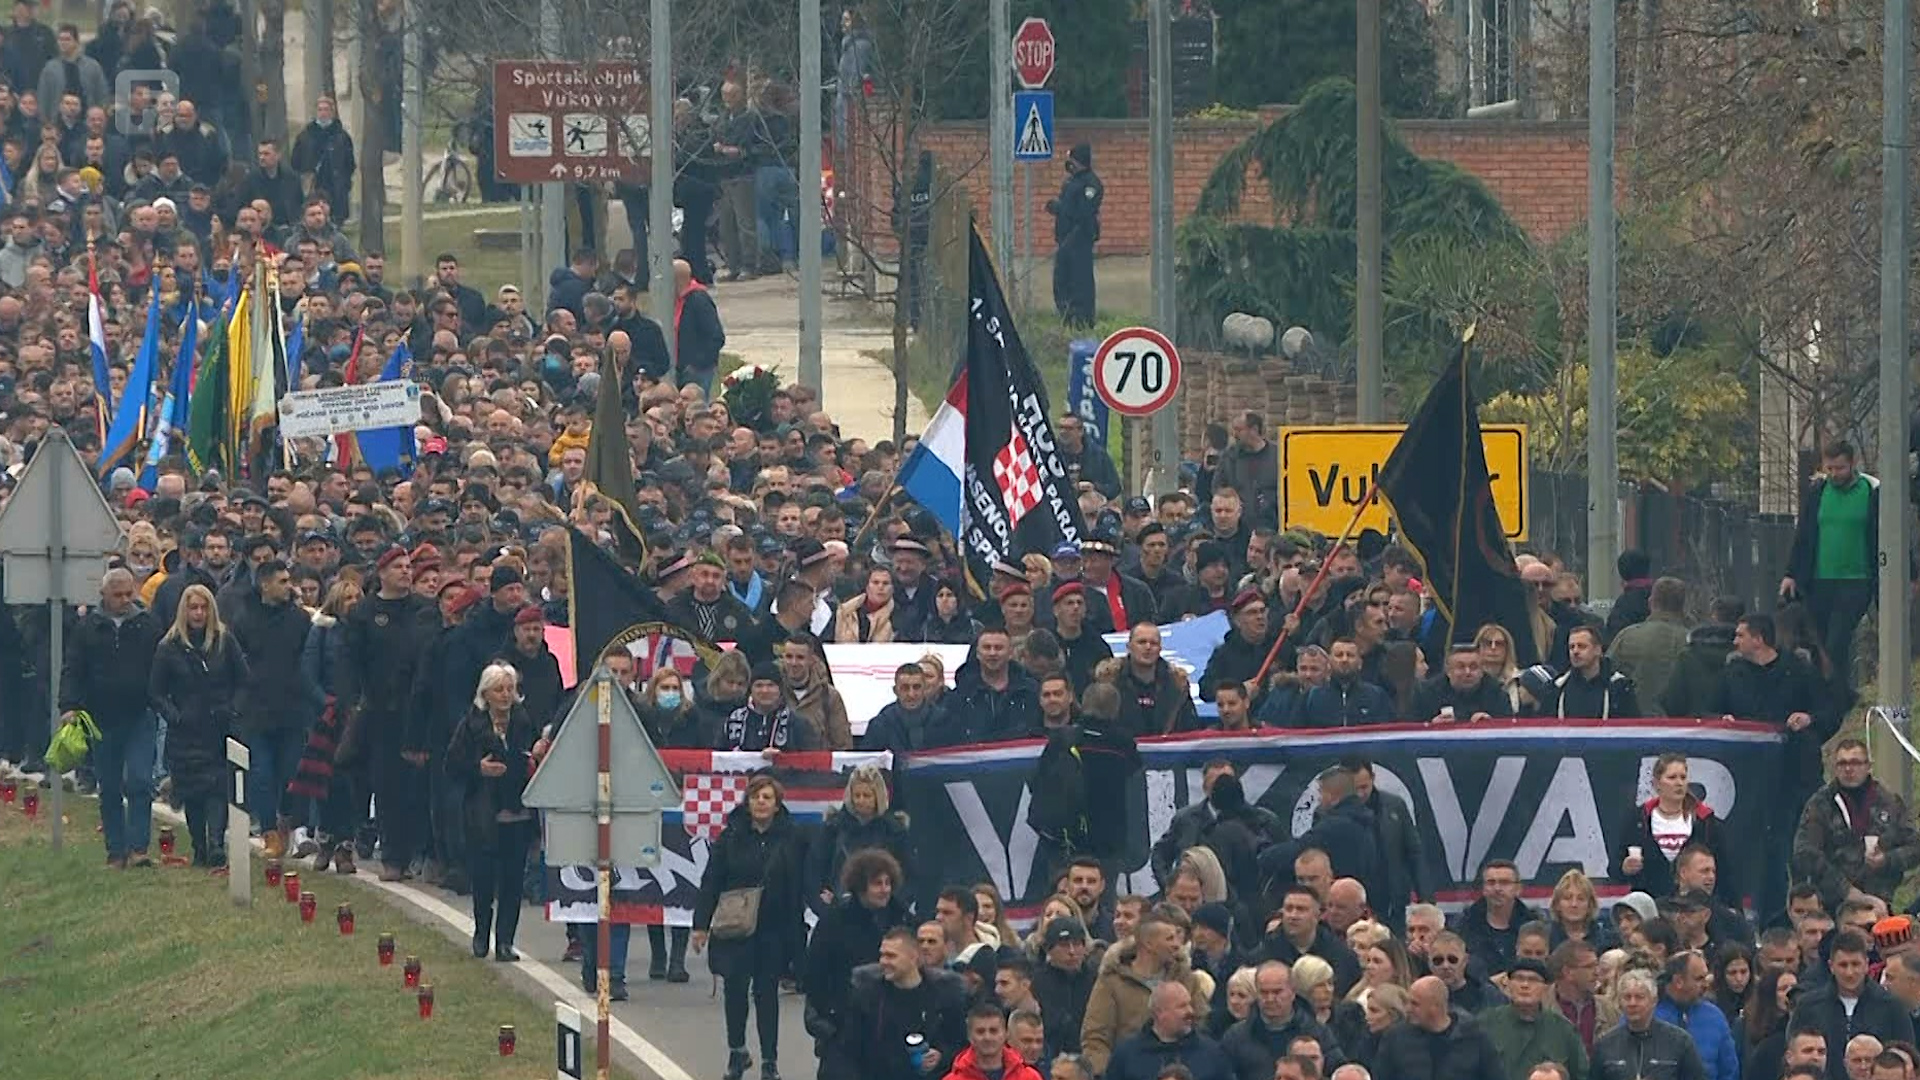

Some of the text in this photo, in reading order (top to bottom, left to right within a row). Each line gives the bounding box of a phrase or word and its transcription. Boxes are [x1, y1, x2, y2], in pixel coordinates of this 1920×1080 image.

[1018, 40, 1051, 66] STOP
[574, 165, 621, 180] 9,7 km
[1114, 351, 1163, 393] 70
